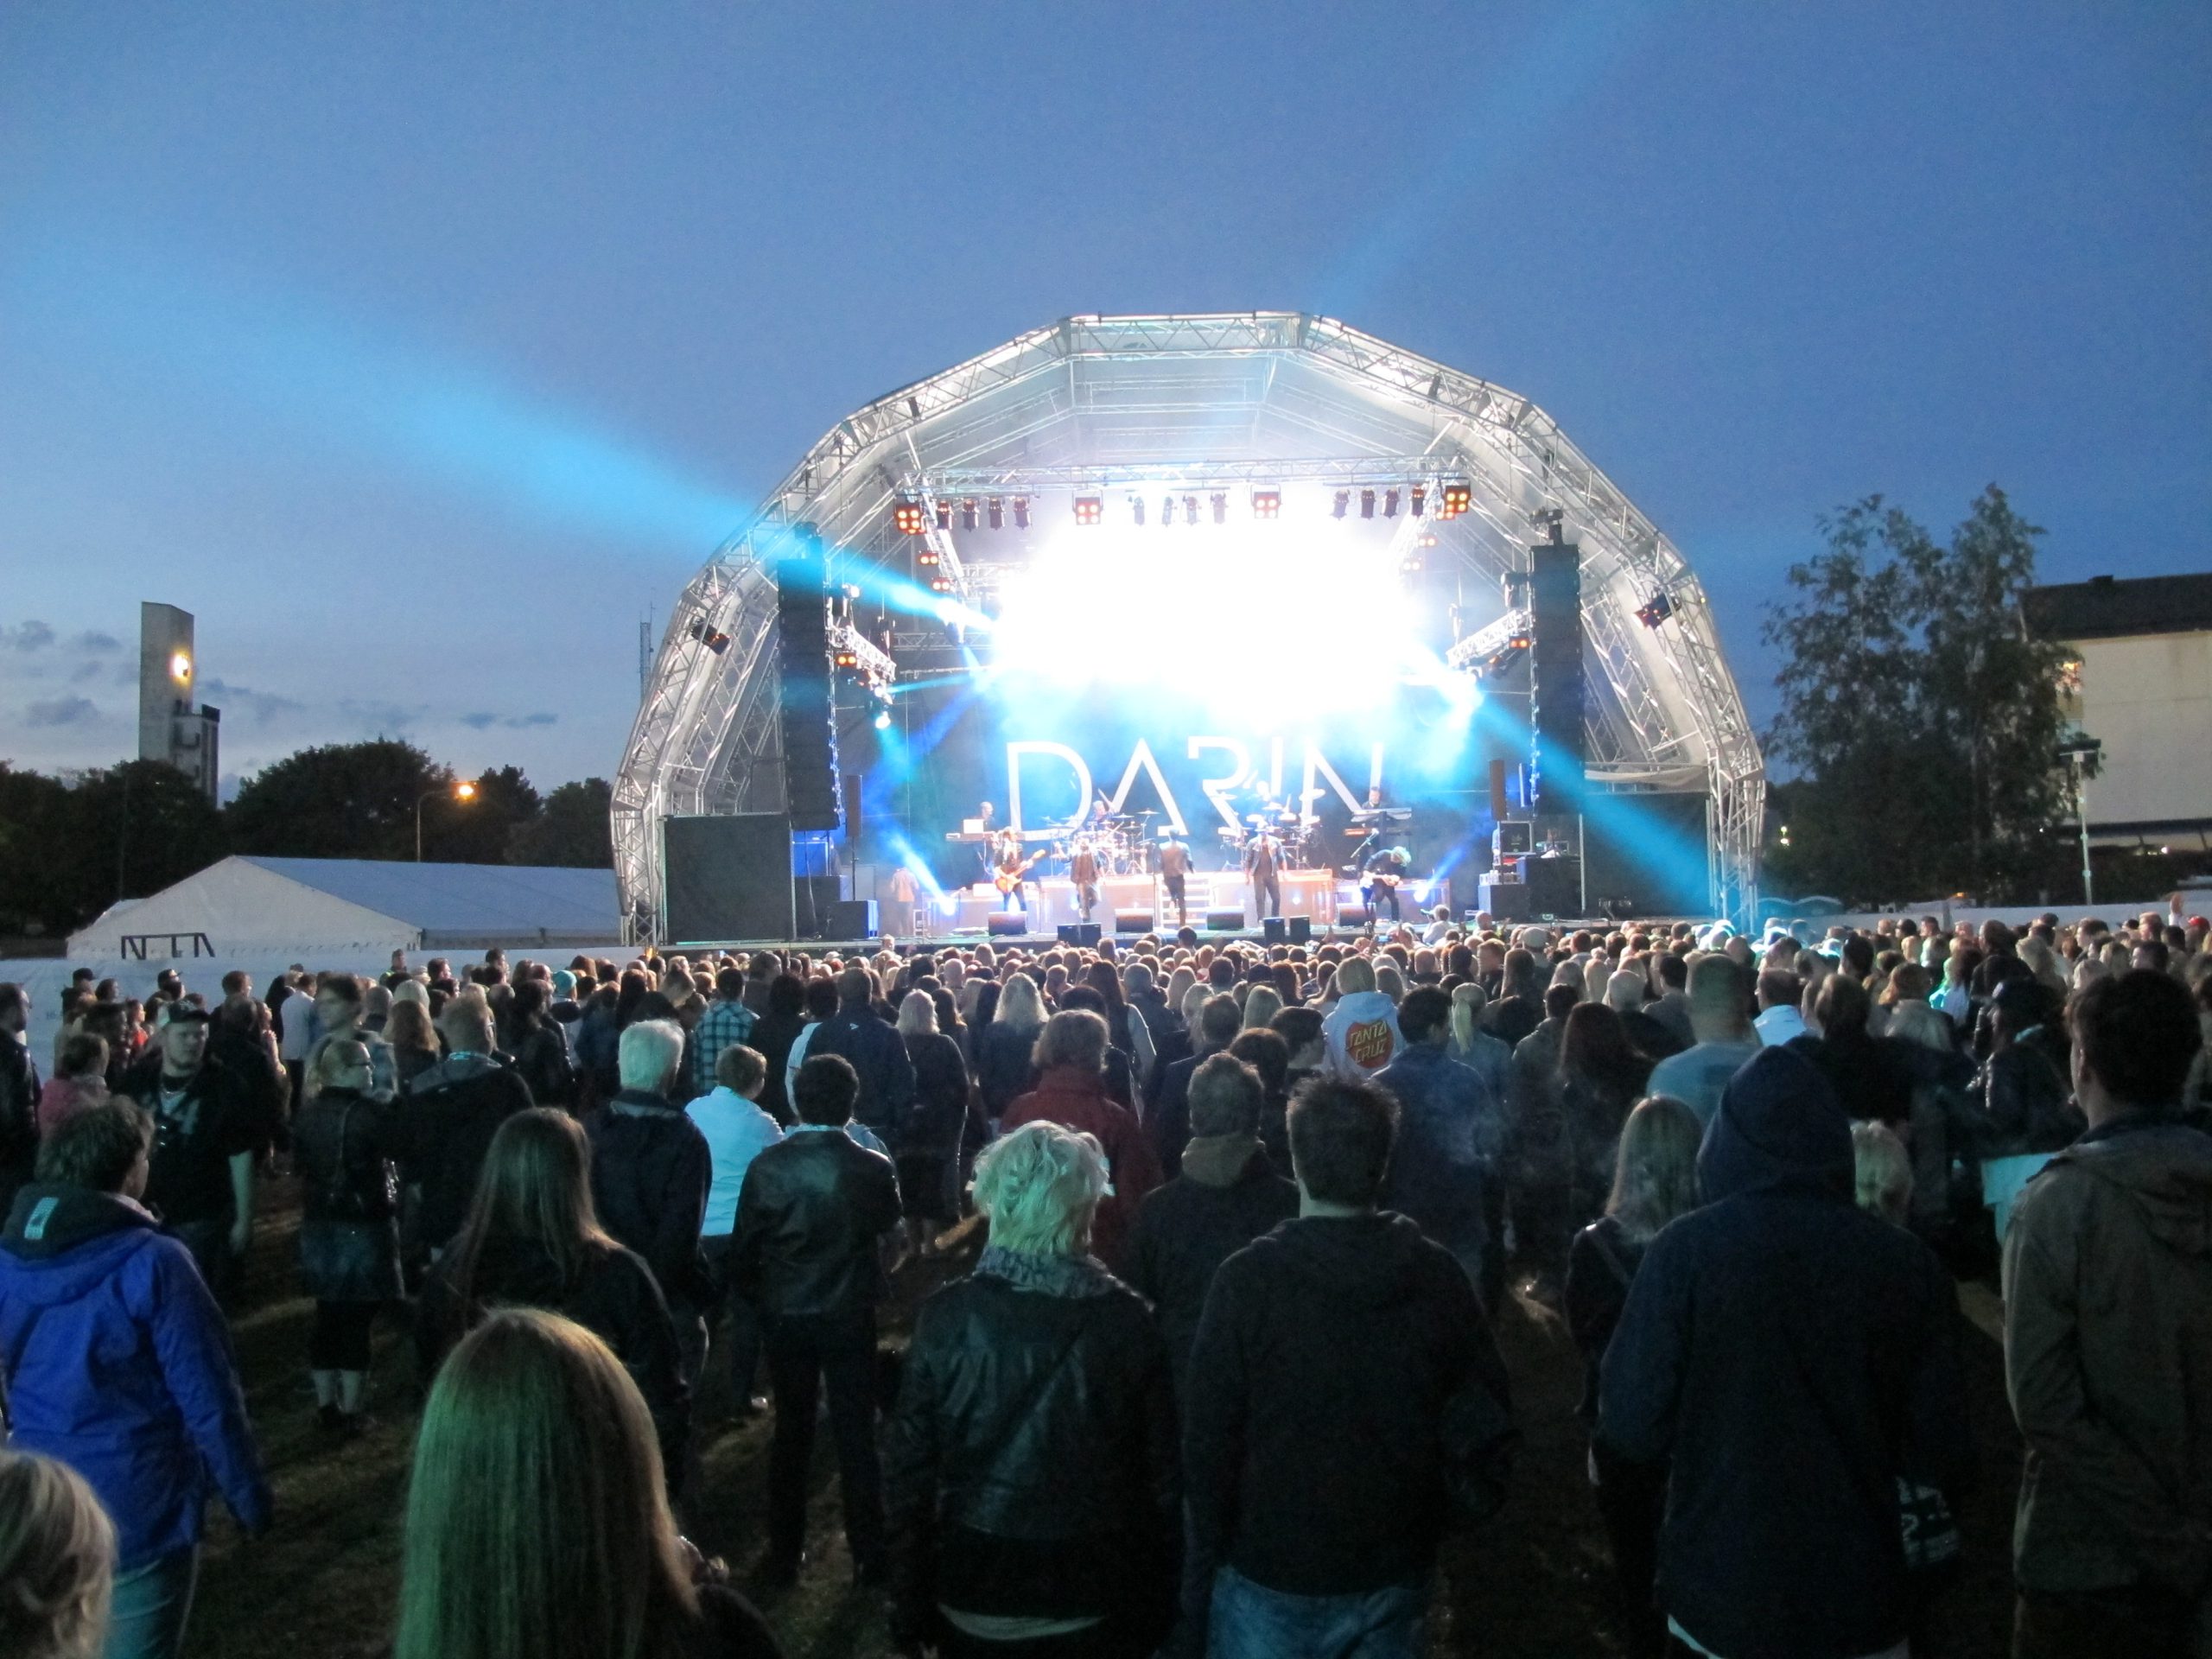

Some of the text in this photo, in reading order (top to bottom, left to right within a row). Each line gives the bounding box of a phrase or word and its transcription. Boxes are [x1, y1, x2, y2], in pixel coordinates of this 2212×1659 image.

[1007, 735, 1383, 841] DARIN
[1345, 1020, 1388, 1050] SANTA
[1355, 1038, 1387, 1064] CRUZ
